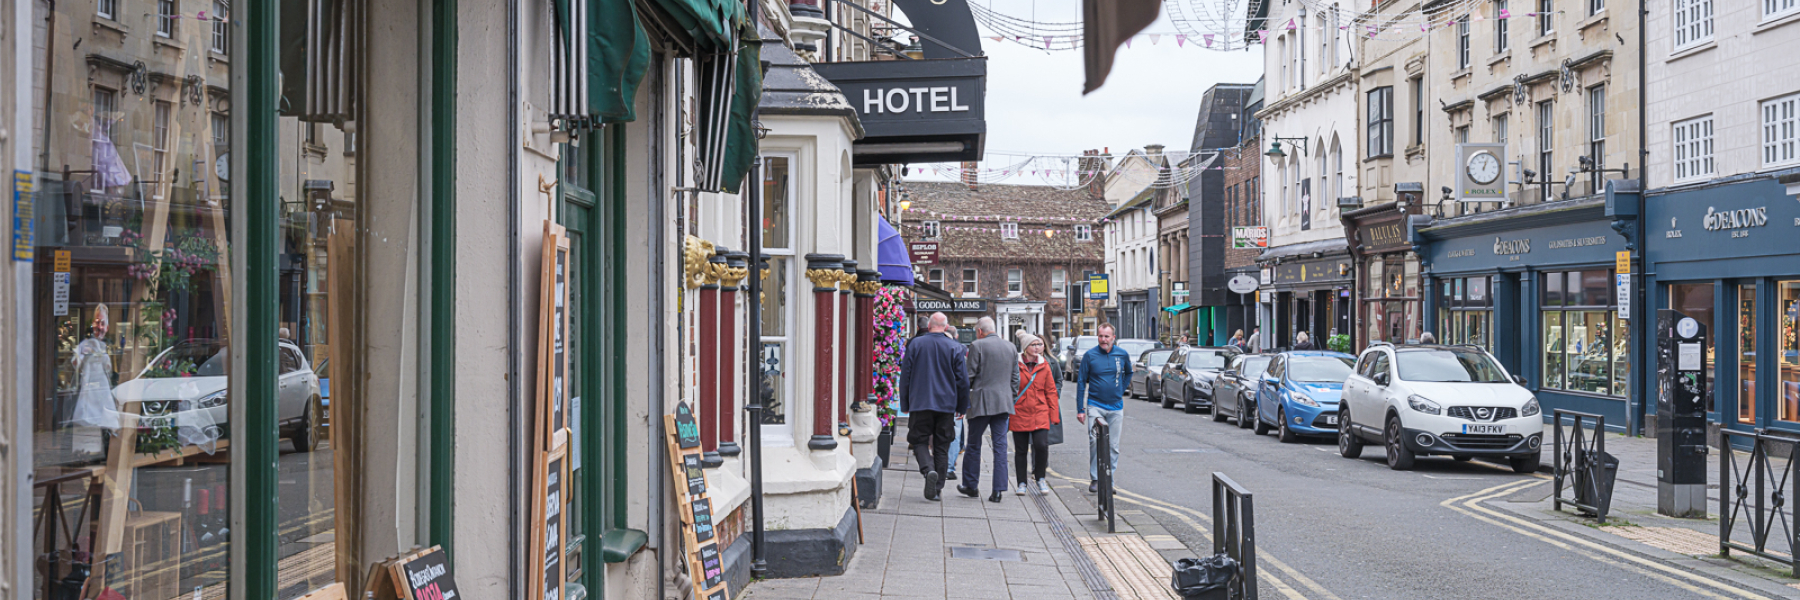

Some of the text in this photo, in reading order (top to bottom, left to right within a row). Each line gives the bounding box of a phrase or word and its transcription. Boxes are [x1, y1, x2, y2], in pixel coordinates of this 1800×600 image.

[863, 86, 969, 114] HOTEL
[1714, 206, 1767, 230] DEACONS
[1500, 239, 1530, 255] DEACONS
[959, 301, 980, 309] ARMS
[1682, 320, 1694, 336] P
[1468, 425, 1502, 433] YA13 FKV
